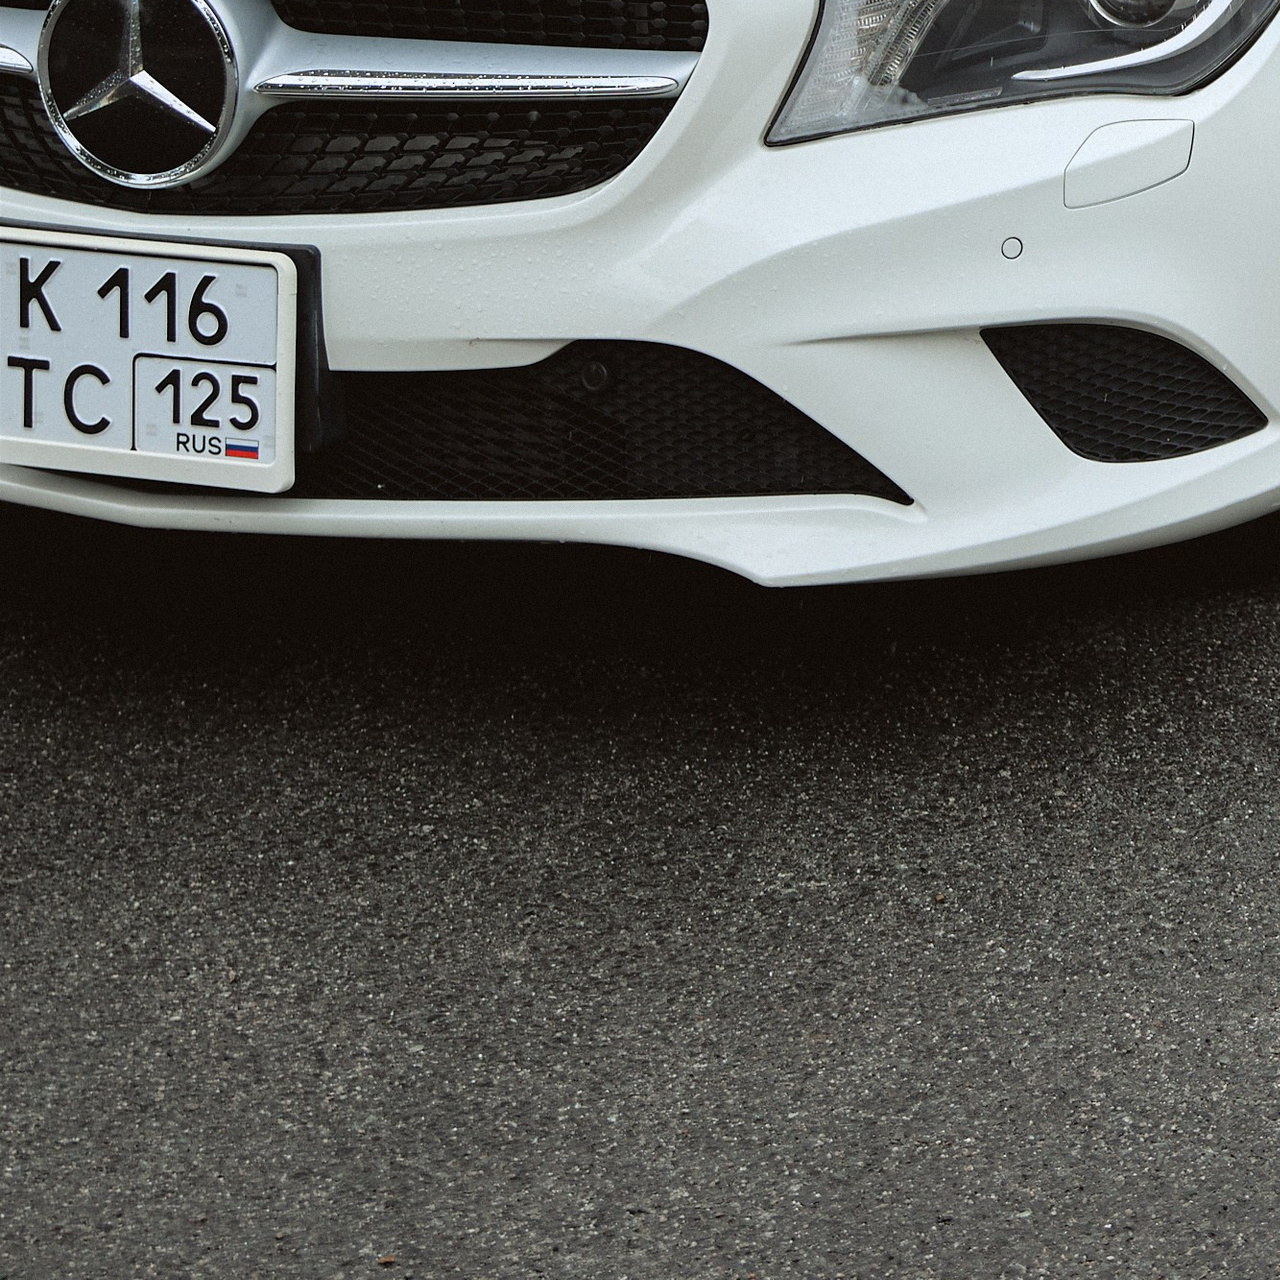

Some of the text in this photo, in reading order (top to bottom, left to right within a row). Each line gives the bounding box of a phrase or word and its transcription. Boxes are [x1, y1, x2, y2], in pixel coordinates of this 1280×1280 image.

[19, 256, 229, 347] K 116
[155, 368, 260, 431] 125
[176, 432, 222, 455] RUS
